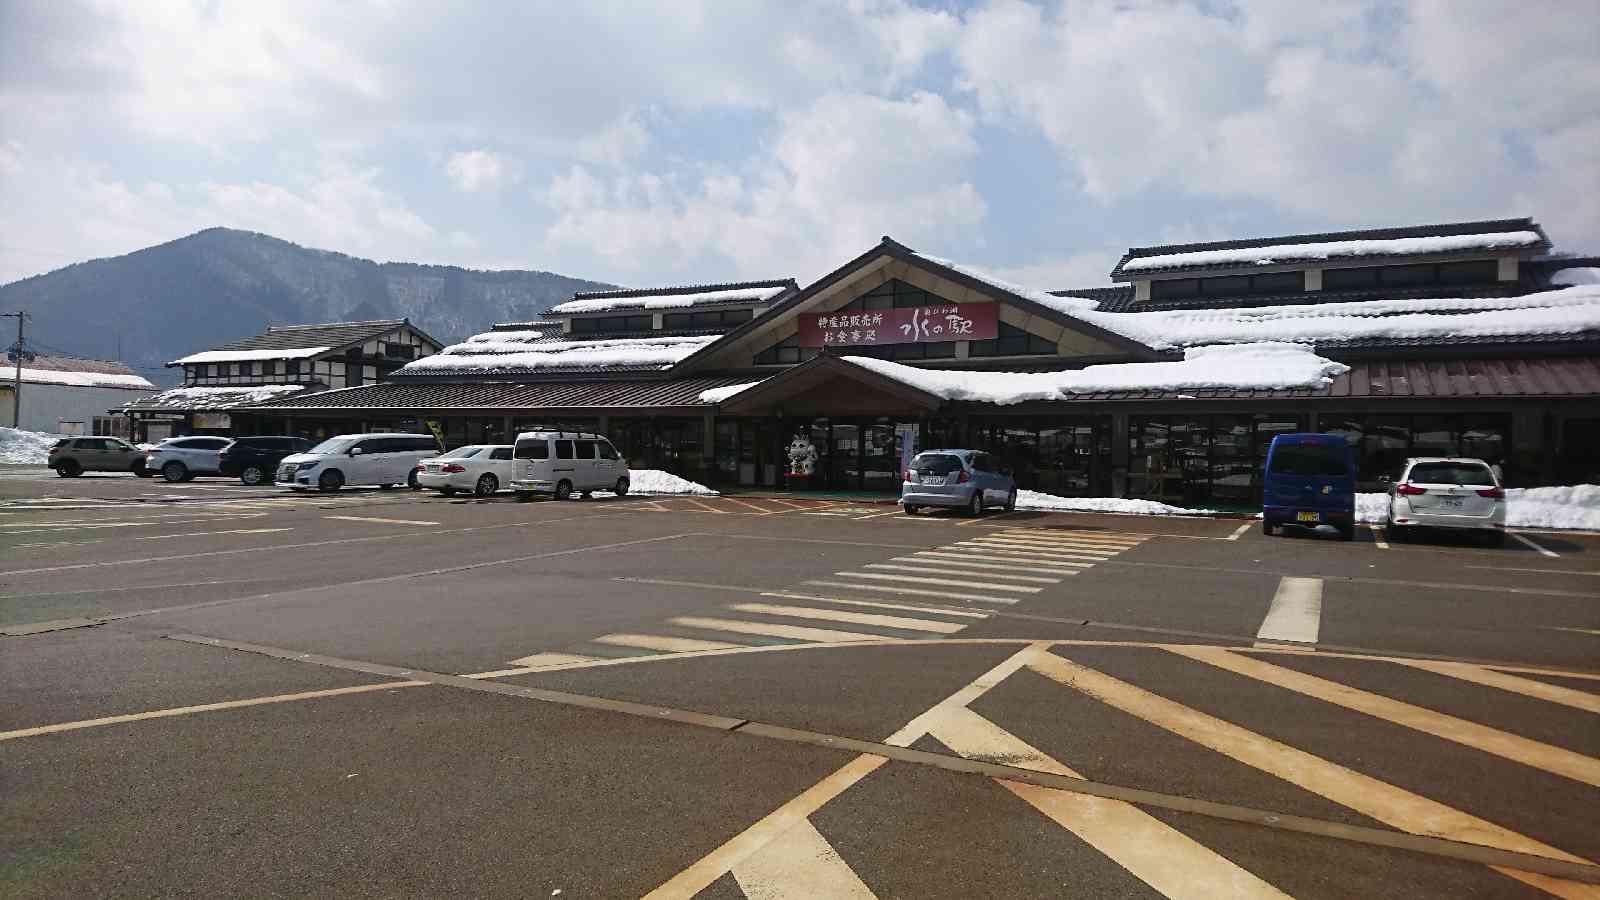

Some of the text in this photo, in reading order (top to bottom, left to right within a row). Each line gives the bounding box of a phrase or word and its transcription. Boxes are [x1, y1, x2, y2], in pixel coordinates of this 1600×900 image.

[818, 313, 883, 328] 特産品販売所
[900, 308, 973, 342] 水の駅
[824, 329, 876, 343] お食事処
